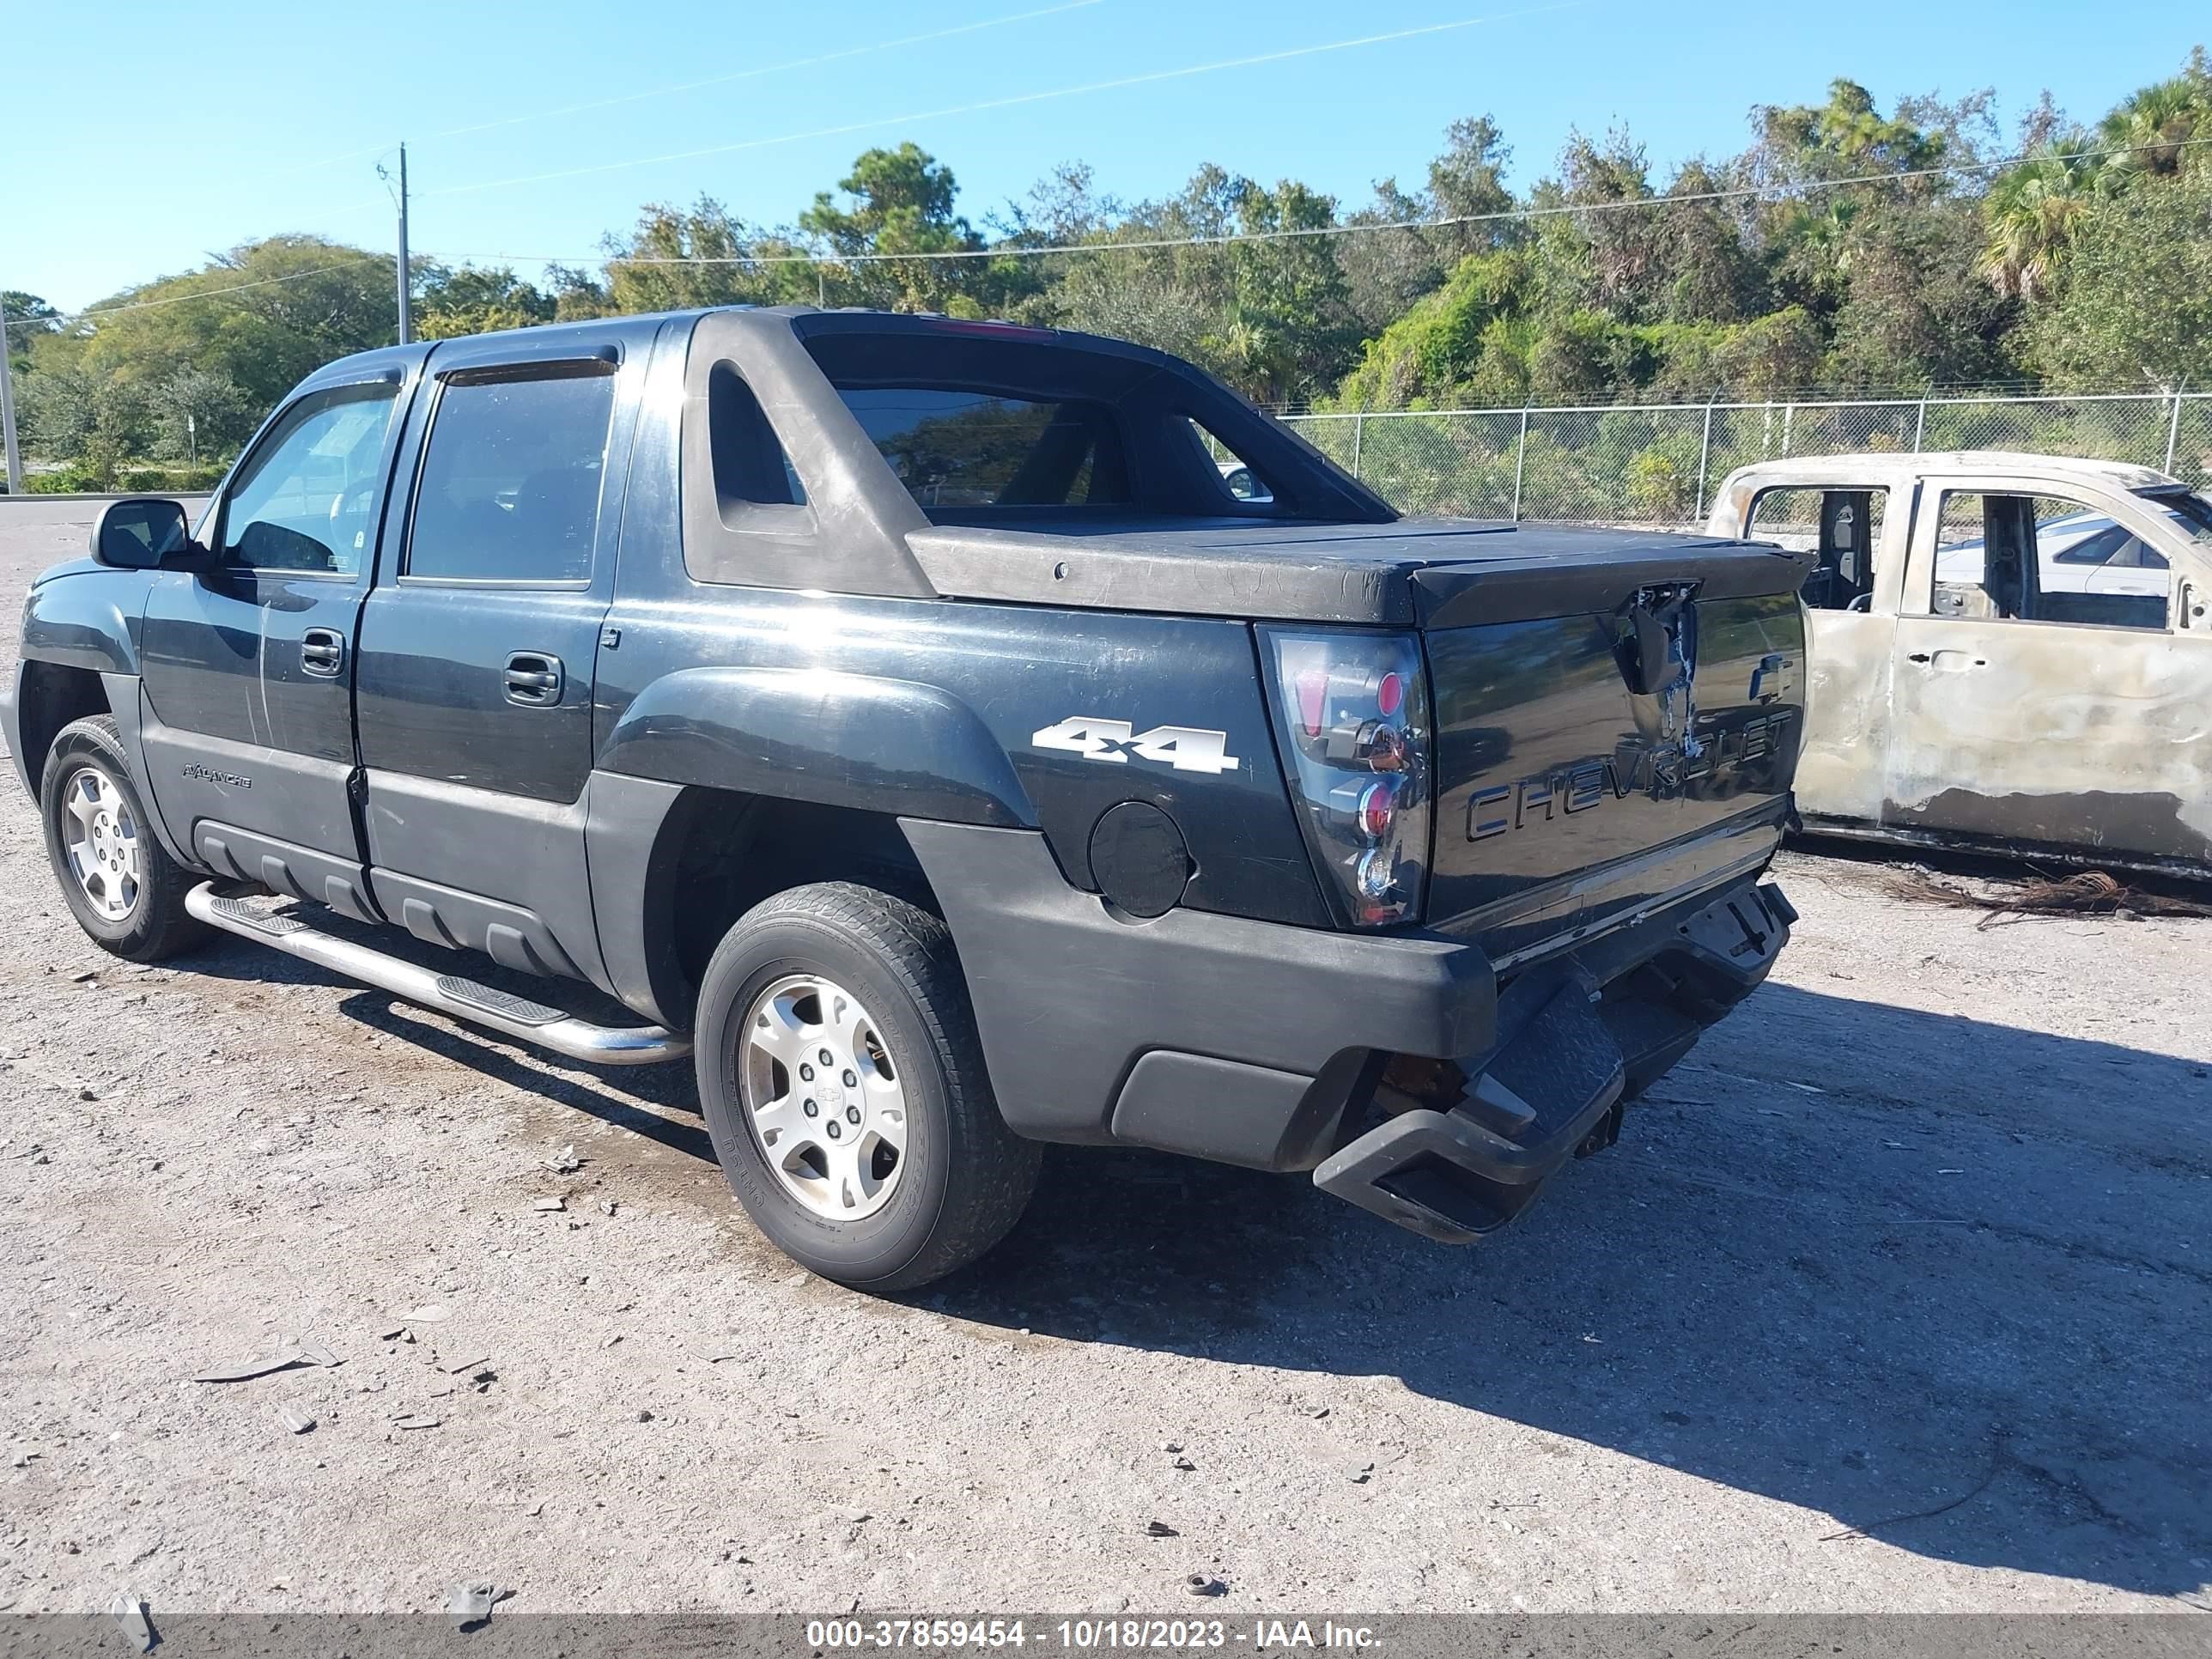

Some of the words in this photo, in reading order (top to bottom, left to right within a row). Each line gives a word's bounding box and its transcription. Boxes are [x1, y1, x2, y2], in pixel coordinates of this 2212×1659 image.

[182, 762, 252, 789] AVALANCHE
[1465, 709, 1793, 843] CHEVROLET
[721, 1139, 766, 1208] OHTSU
